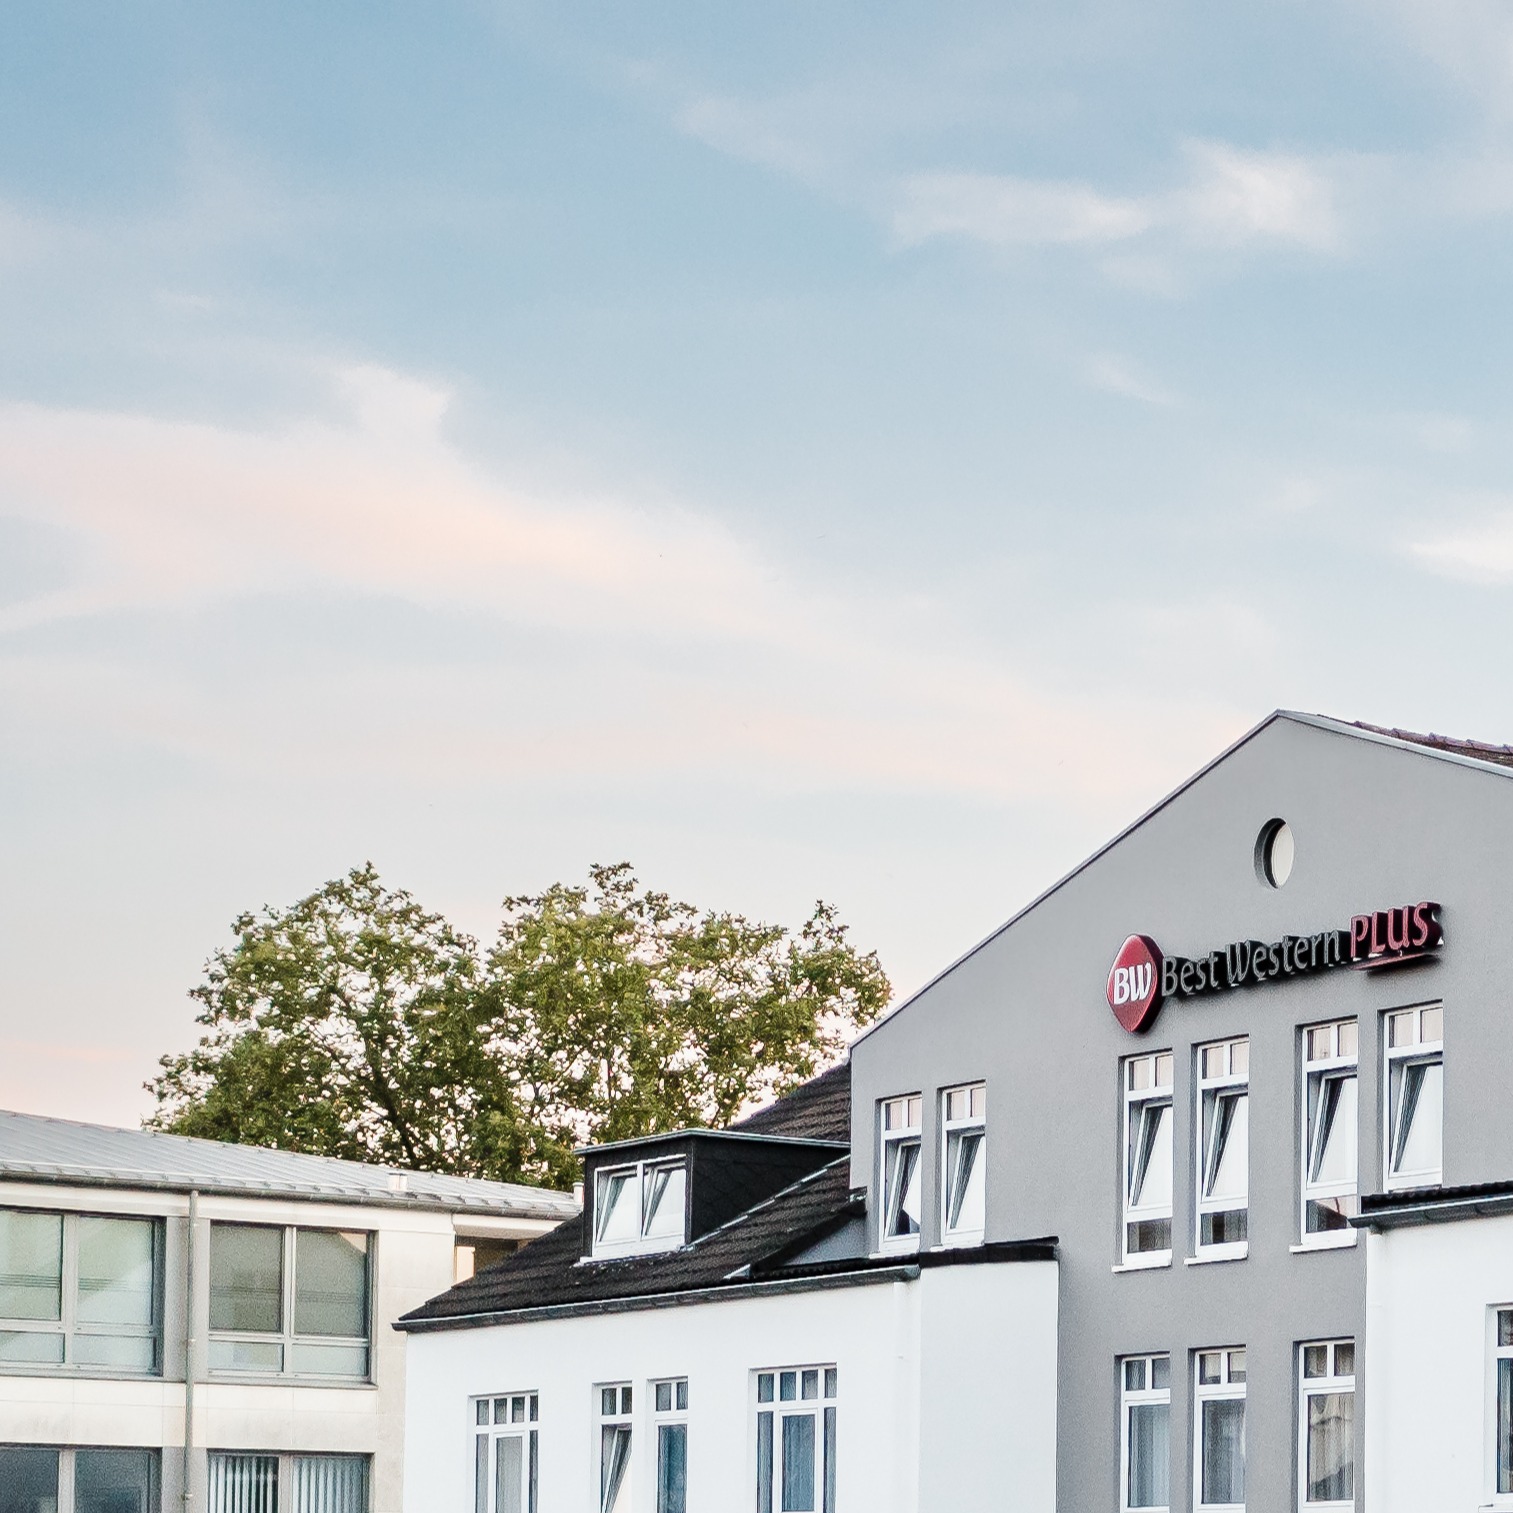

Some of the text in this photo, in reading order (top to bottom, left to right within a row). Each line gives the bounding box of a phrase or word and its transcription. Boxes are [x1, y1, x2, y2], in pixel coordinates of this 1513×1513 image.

[1113, 962, 1152, 1005] BW
[1161, 902, 1440, 997] Best Western PLUS
